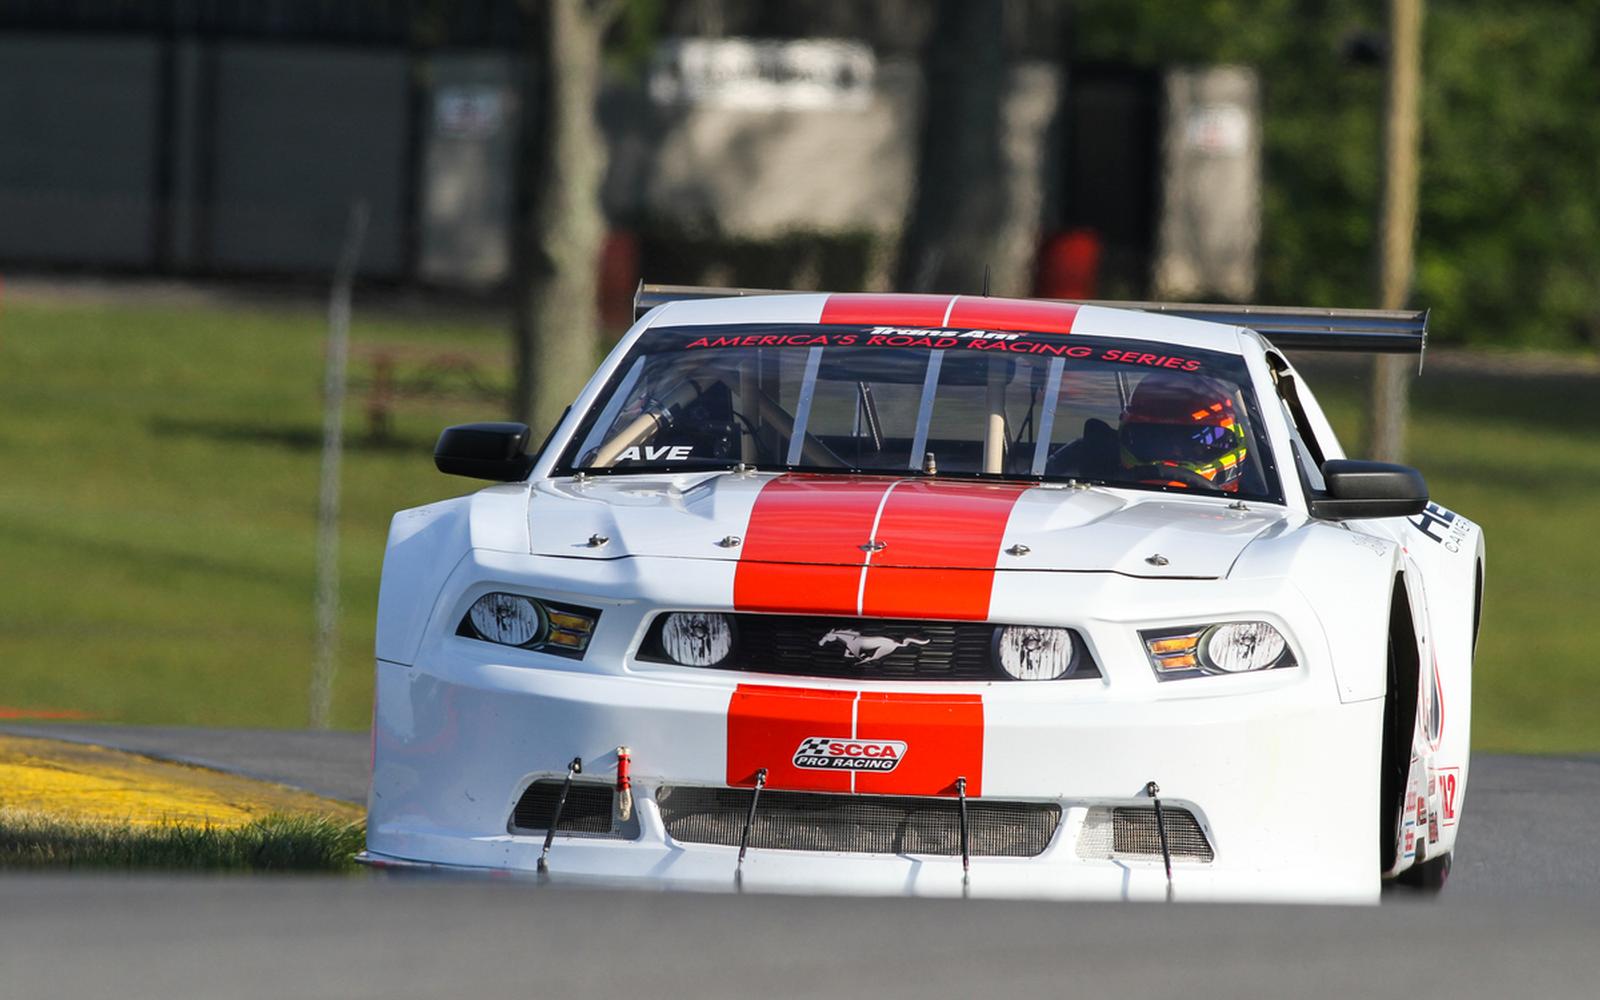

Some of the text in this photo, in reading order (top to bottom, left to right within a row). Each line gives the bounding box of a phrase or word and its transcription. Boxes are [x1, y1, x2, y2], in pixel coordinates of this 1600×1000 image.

[870, 326, 1021, 340] Trans Am
[686, 335, 1201, 372] AMERICA'S ROAD RACING SERIES
[614, 445, 693, 461] AVE
[828, 743, 897, 759] SCCA
[796, 756, 894, 769] PRO RACING
